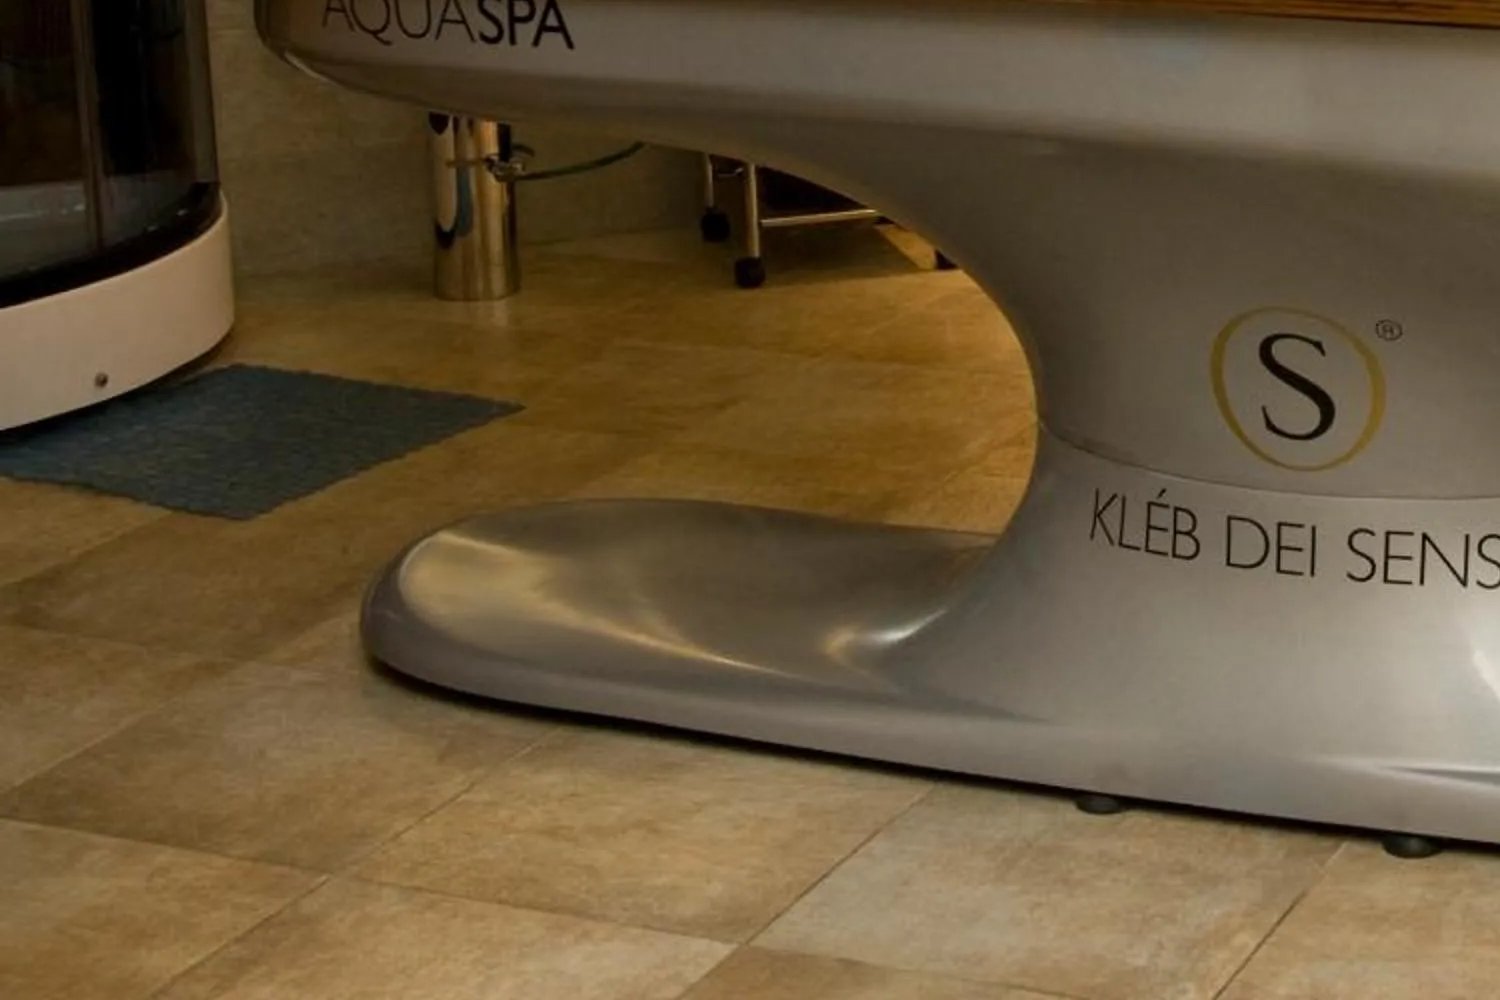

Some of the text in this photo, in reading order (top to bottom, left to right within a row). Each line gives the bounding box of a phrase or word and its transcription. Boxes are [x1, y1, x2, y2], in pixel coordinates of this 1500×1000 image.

[1258, 332, 1336, 441] S
[1089, 487, 1201, 562] KLÉB
[1225, 514, 1317, 578] DEI
